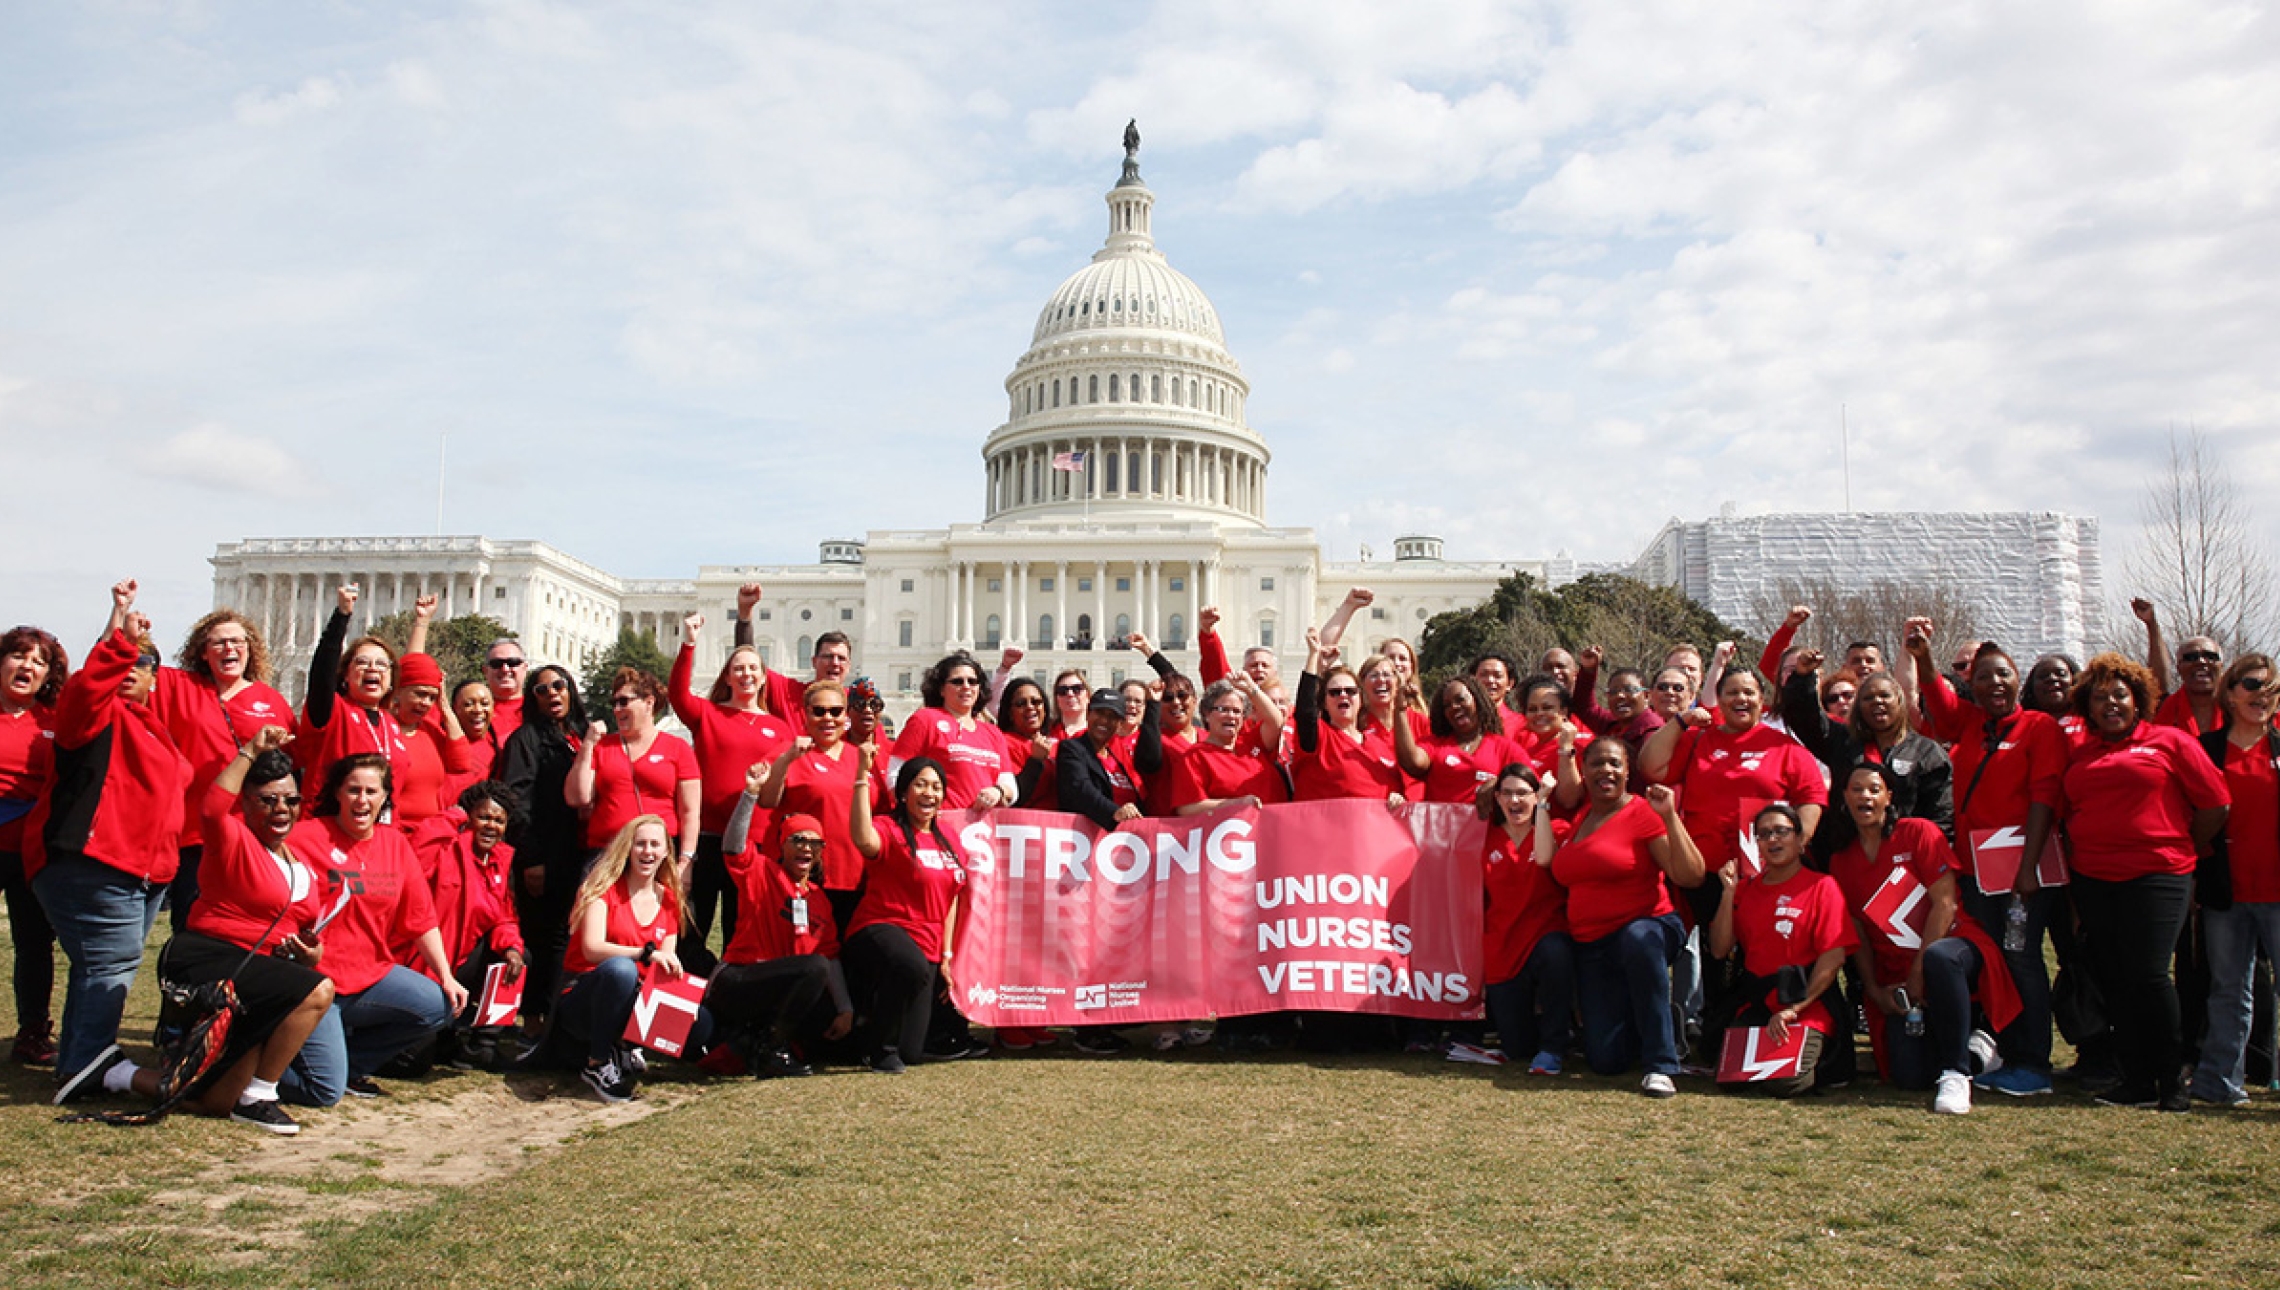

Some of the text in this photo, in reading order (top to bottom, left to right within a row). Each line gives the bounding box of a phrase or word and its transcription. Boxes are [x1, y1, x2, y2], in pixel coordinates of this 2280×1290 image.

[960, 819, 1257, 884] STRONG
[1257, 874, 1388, 908] UNION
[1258, 917, 1412, 955] NURSES
[1108, 981, 1147, 989] National
[1258, 961, 1469, 1004] VETERANS
[999, 984, 1066, 995] National Nurses
[1108, 991, 1140, 999] Nurses
[999, 994, 1047, 1004] Organizing
[1108, 999, 1140, 1008] United
